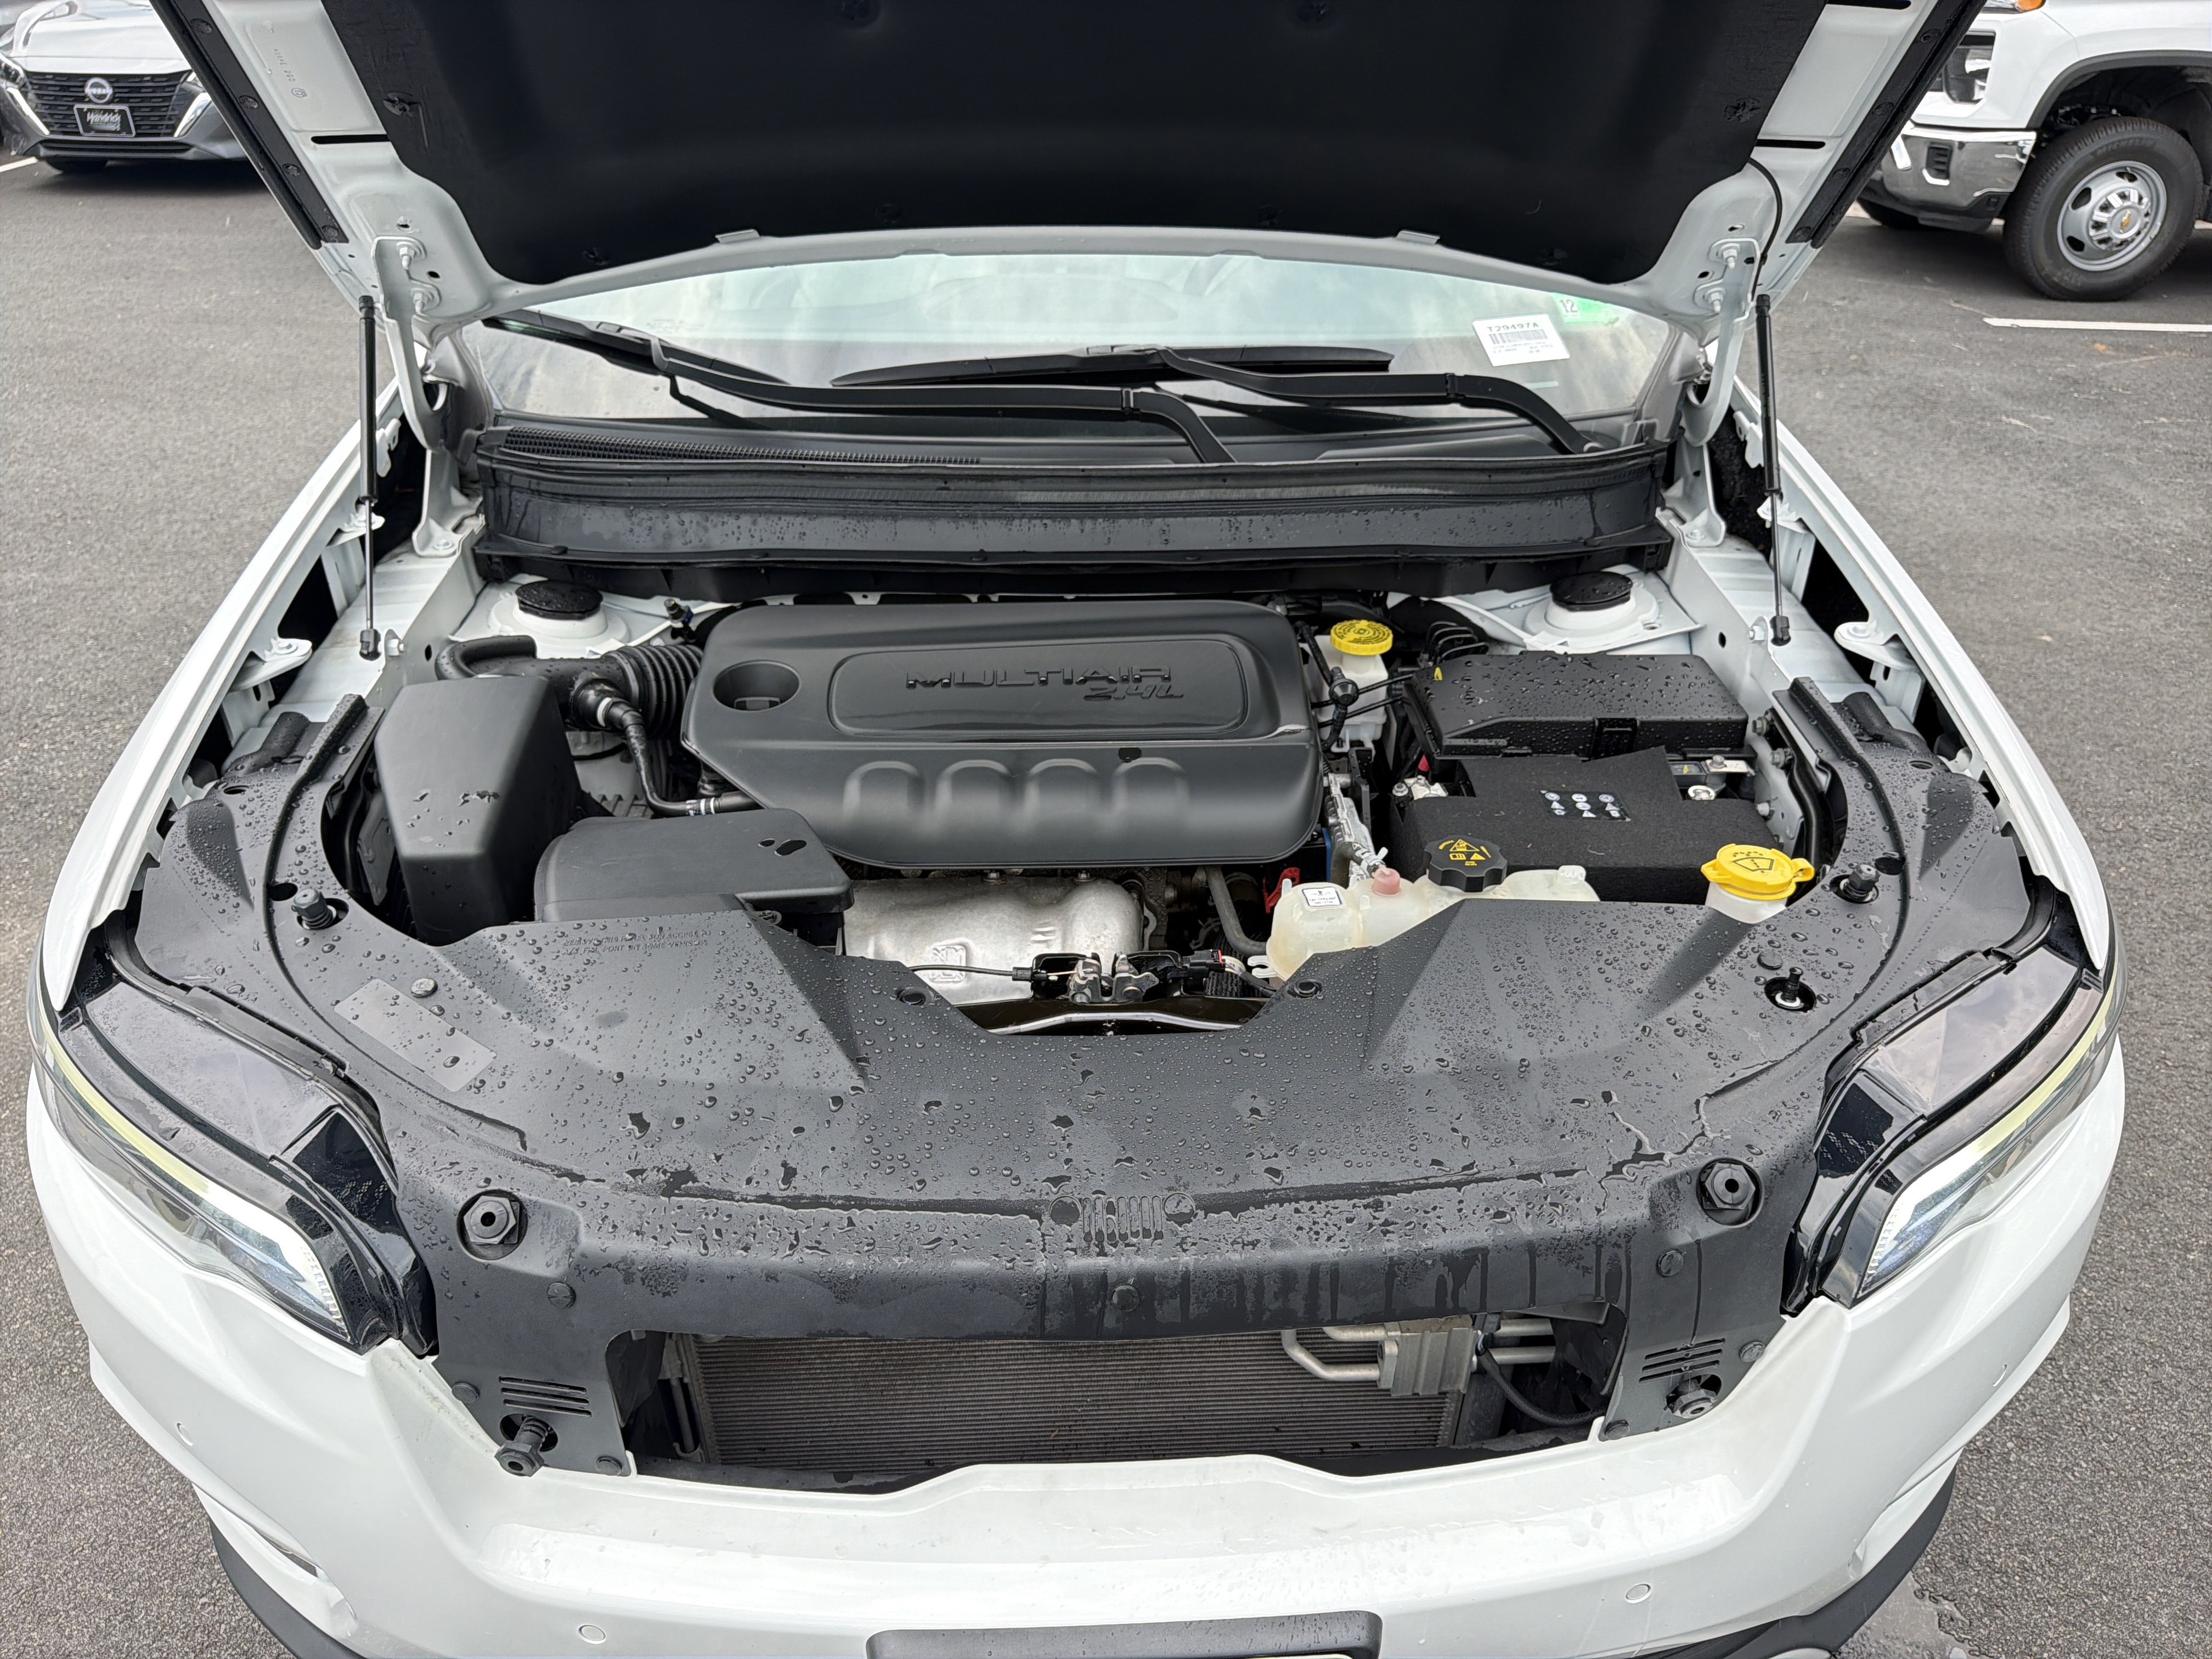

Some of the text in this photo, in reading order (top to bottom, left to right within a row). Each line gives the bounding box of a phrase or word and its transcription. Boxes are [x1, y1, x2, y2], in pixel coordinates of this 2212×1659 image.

[1559, 299, 1578, 313] 12
[906, 667, 1171, 689] MULTIAIR
[1084, 684, 1184, 701] 2.4L
[563, 937, 601, 946] REMOV
[620, 934, 646, 943] PEL
[669, 939, 708, 949] VEHICES
